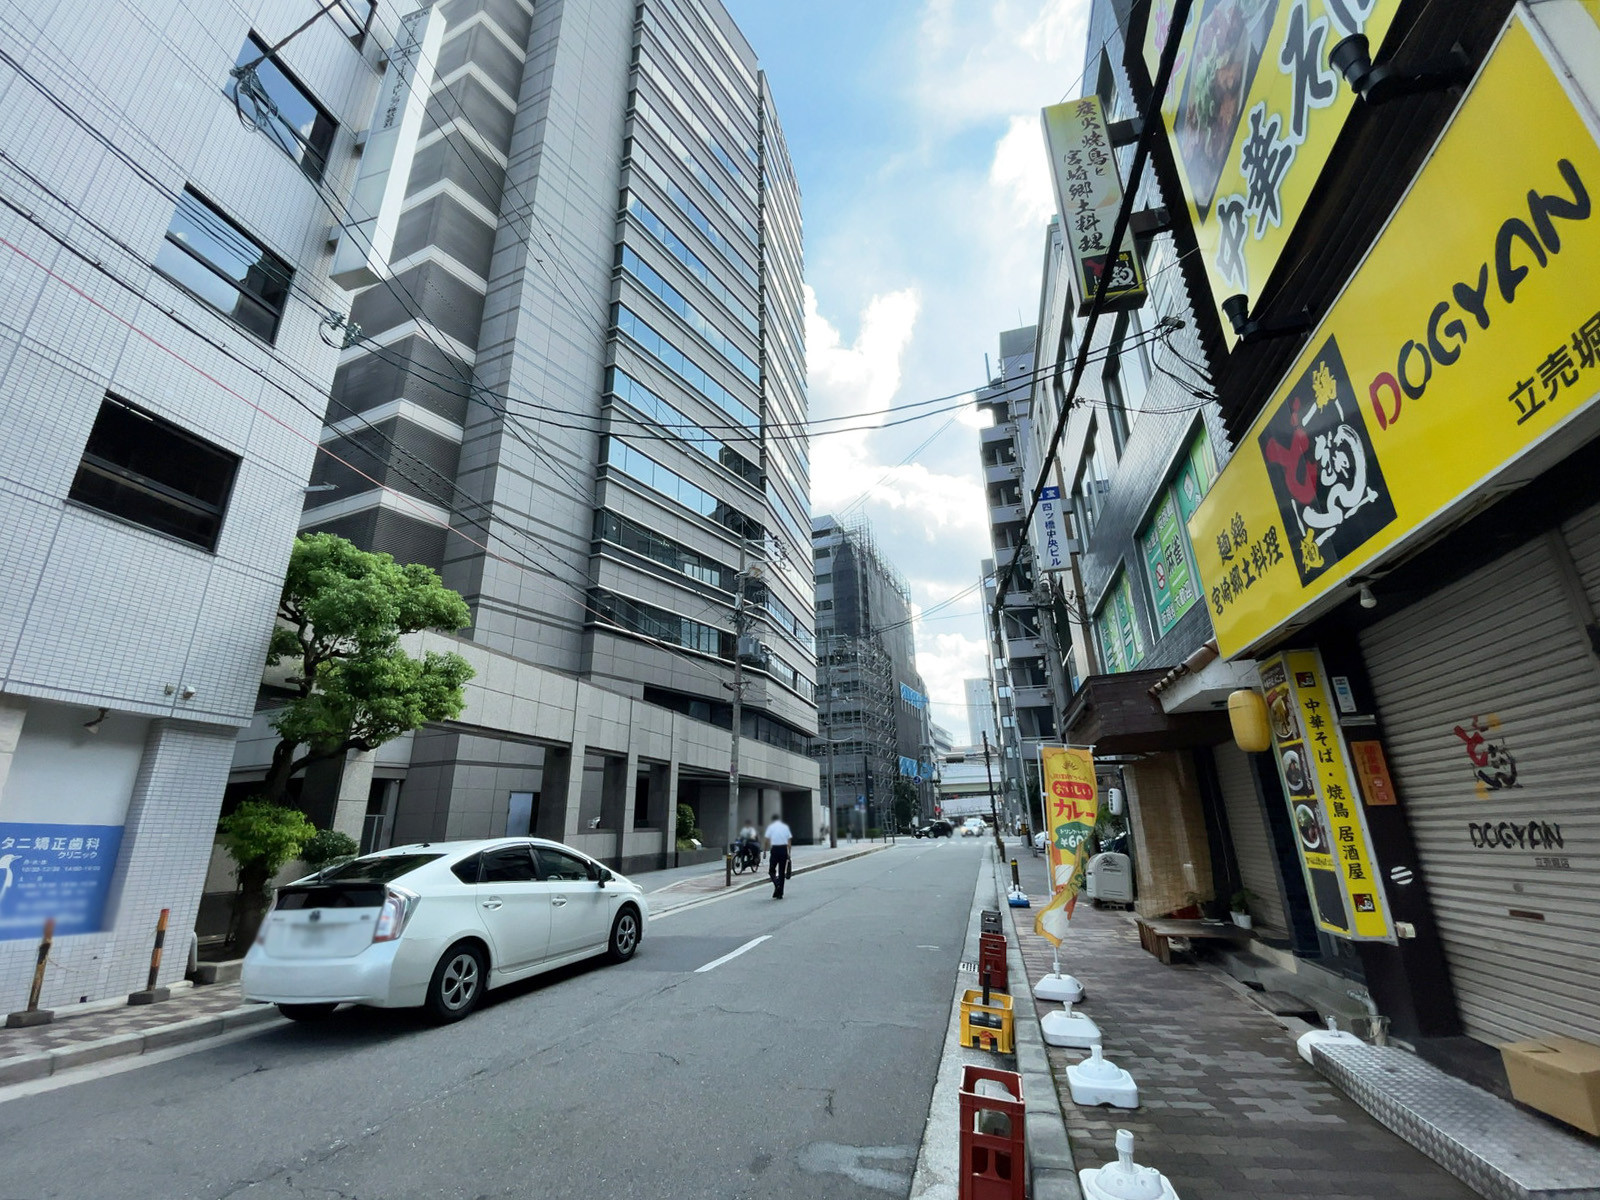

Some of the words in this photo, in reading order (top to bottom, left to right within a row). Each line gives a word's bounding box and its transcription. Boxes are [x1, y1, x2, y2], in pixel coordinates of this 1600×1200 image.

[1064, 150, 1106, 252] 宮崎郷土料理
[1369, 158, 1591, 431] DOGYAN
[1042, 502, 1061, 566] 四ツ橋中央ビル
[1211, 525, 1284, 616] 宮崎郷土料理
[1056, 783, 1092, 796] おいしい
[1053, 799, 1096, 821] カレー
[1, 836, 100, 850] タニ矯正歯科
[1469, 820, 1564, 849] DOGYAN
[57, 851, 98, 859] クリニック
